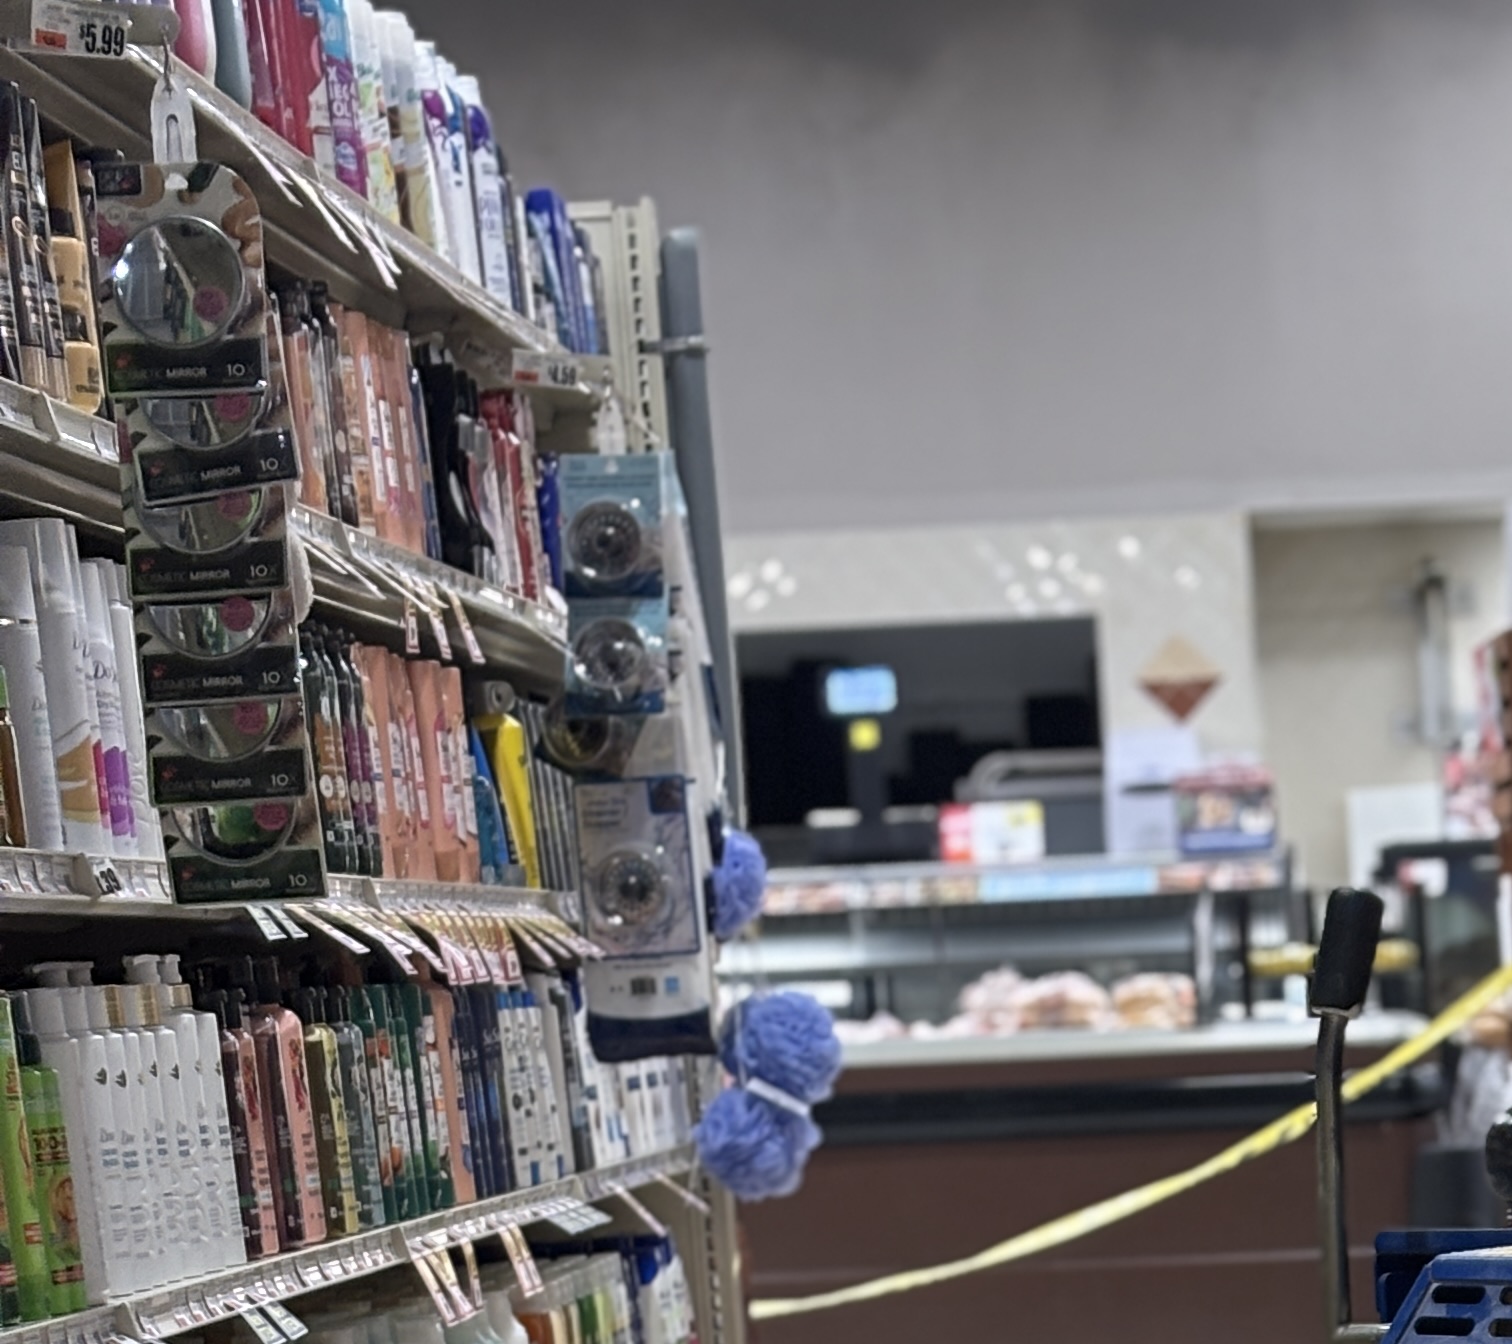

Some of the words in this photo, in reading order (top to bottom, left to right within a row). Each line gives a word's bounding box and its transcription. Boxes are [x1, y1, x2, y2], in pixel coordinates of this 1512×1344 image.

[79, 23, 125, 57] $5.99
[166, 366, 208, 379] MIRROR
[201, 465, 242, 480] MIRROR
[189, 568, 231, 580] MIRROR
[202, 675, 244, 688] MIRROR
[211, 777, 252, 789] MIRROR
[230, 877, 271, 889] MIRROR
